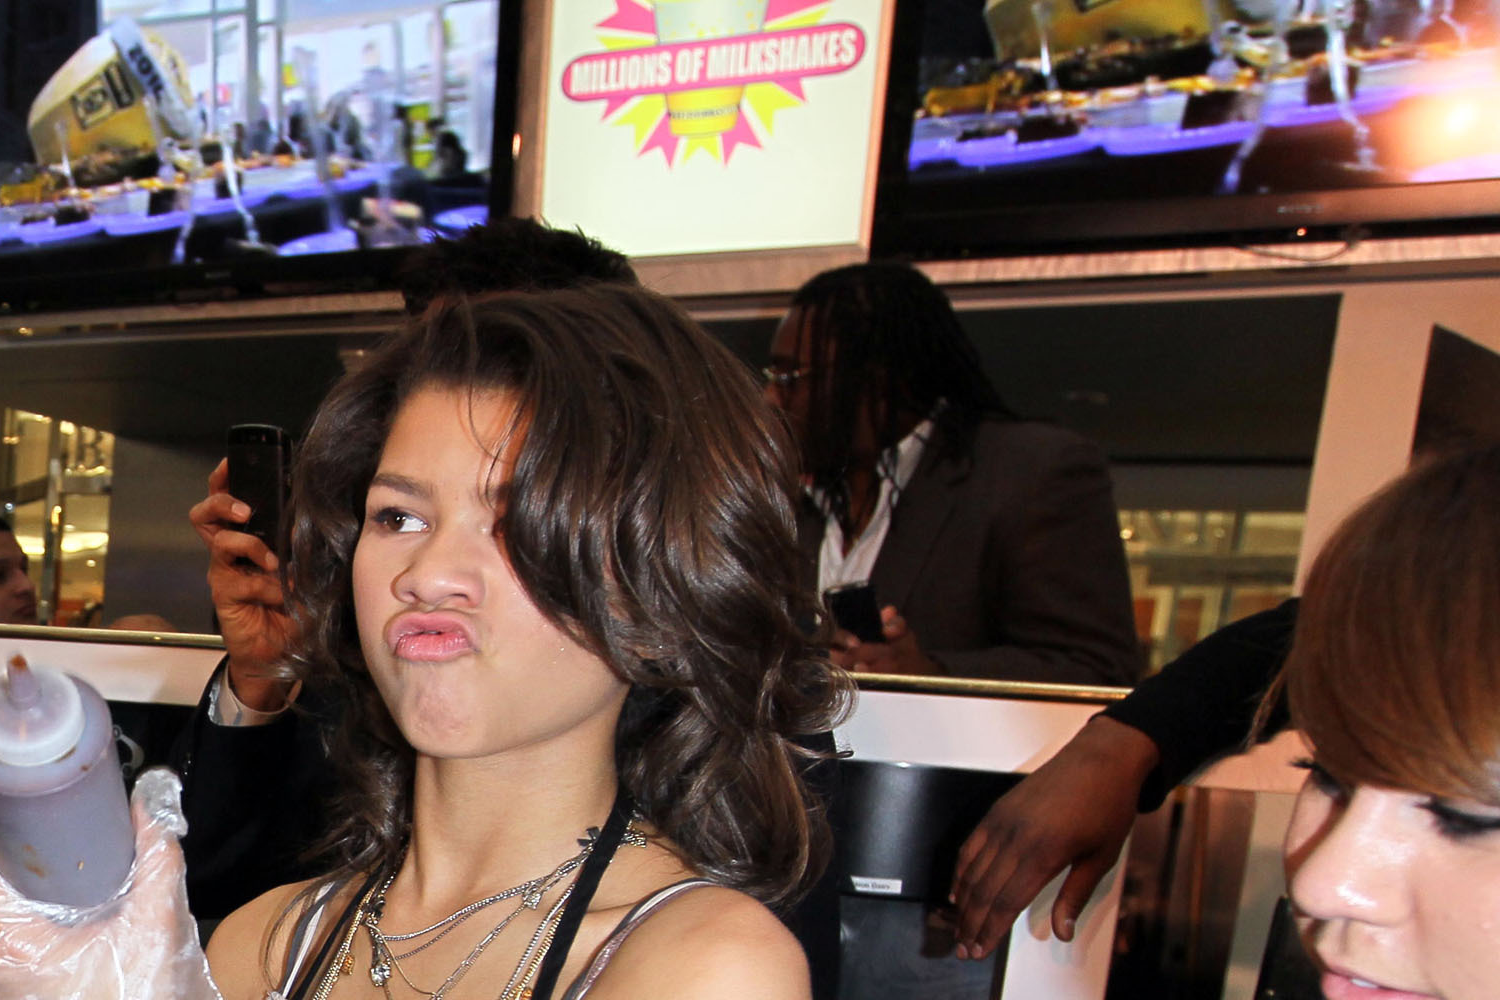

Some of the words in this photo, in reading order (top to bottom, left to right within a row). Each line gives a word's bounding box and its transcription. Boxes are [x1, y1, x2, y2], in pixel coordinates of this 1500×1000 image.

[570, 51, 672, 94] MILLIONS
[675, 47, 706, 84] OF
[706, 29, 859, 80] MILKSHAKES
